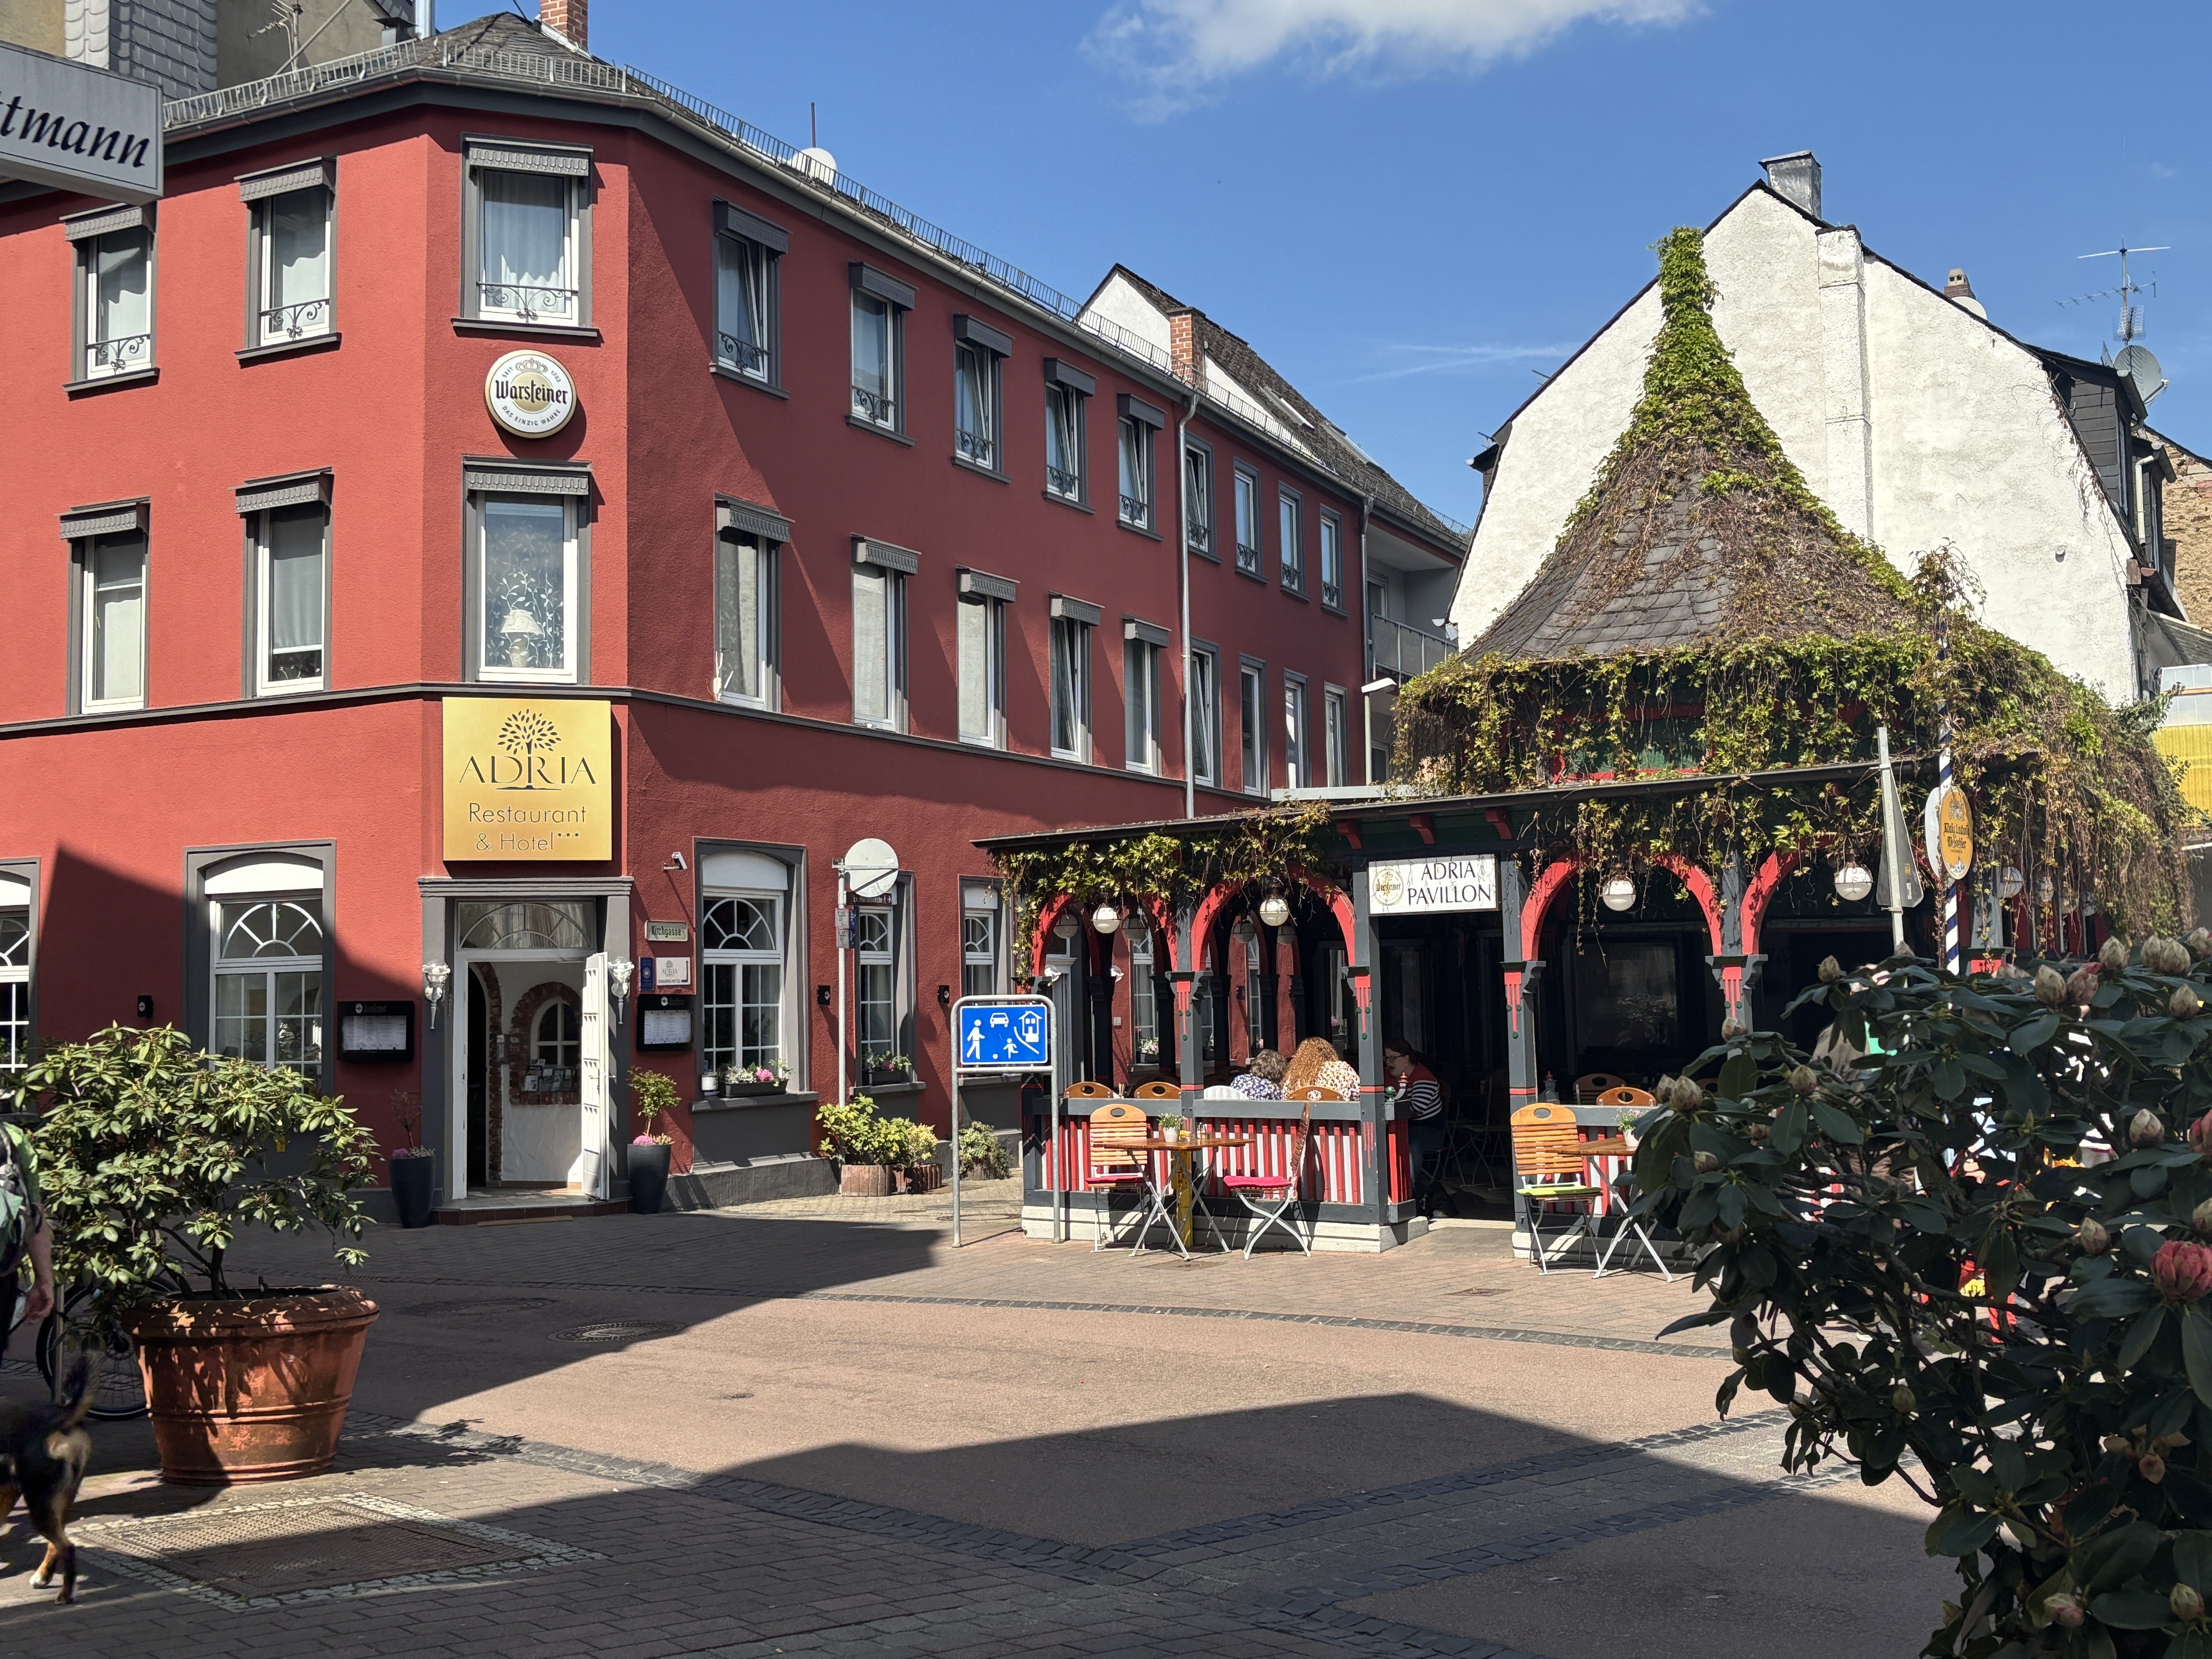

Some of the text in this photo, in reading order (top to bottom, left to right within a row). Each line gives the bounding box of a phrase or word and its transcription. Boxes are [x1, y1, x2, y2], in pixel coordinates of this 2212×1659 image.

[0, 91, 150, 168] tmann
[502, 367, 514, 378] SEIT
[495, 380, 568, 405] Warsteiner
[502, 405, 561, 426] DAS EINZIG WAHRE
[459, 756, 596, 785] ADRIA
[469, 802, 587, 823] Restaurant
[476, 833, 492, 851] &
[1421, 861, 1476, 881] ADRIA
[1407, 884, 1491, 905] PAVILLON
[651, 925, 682, 938] Kirchgasse
